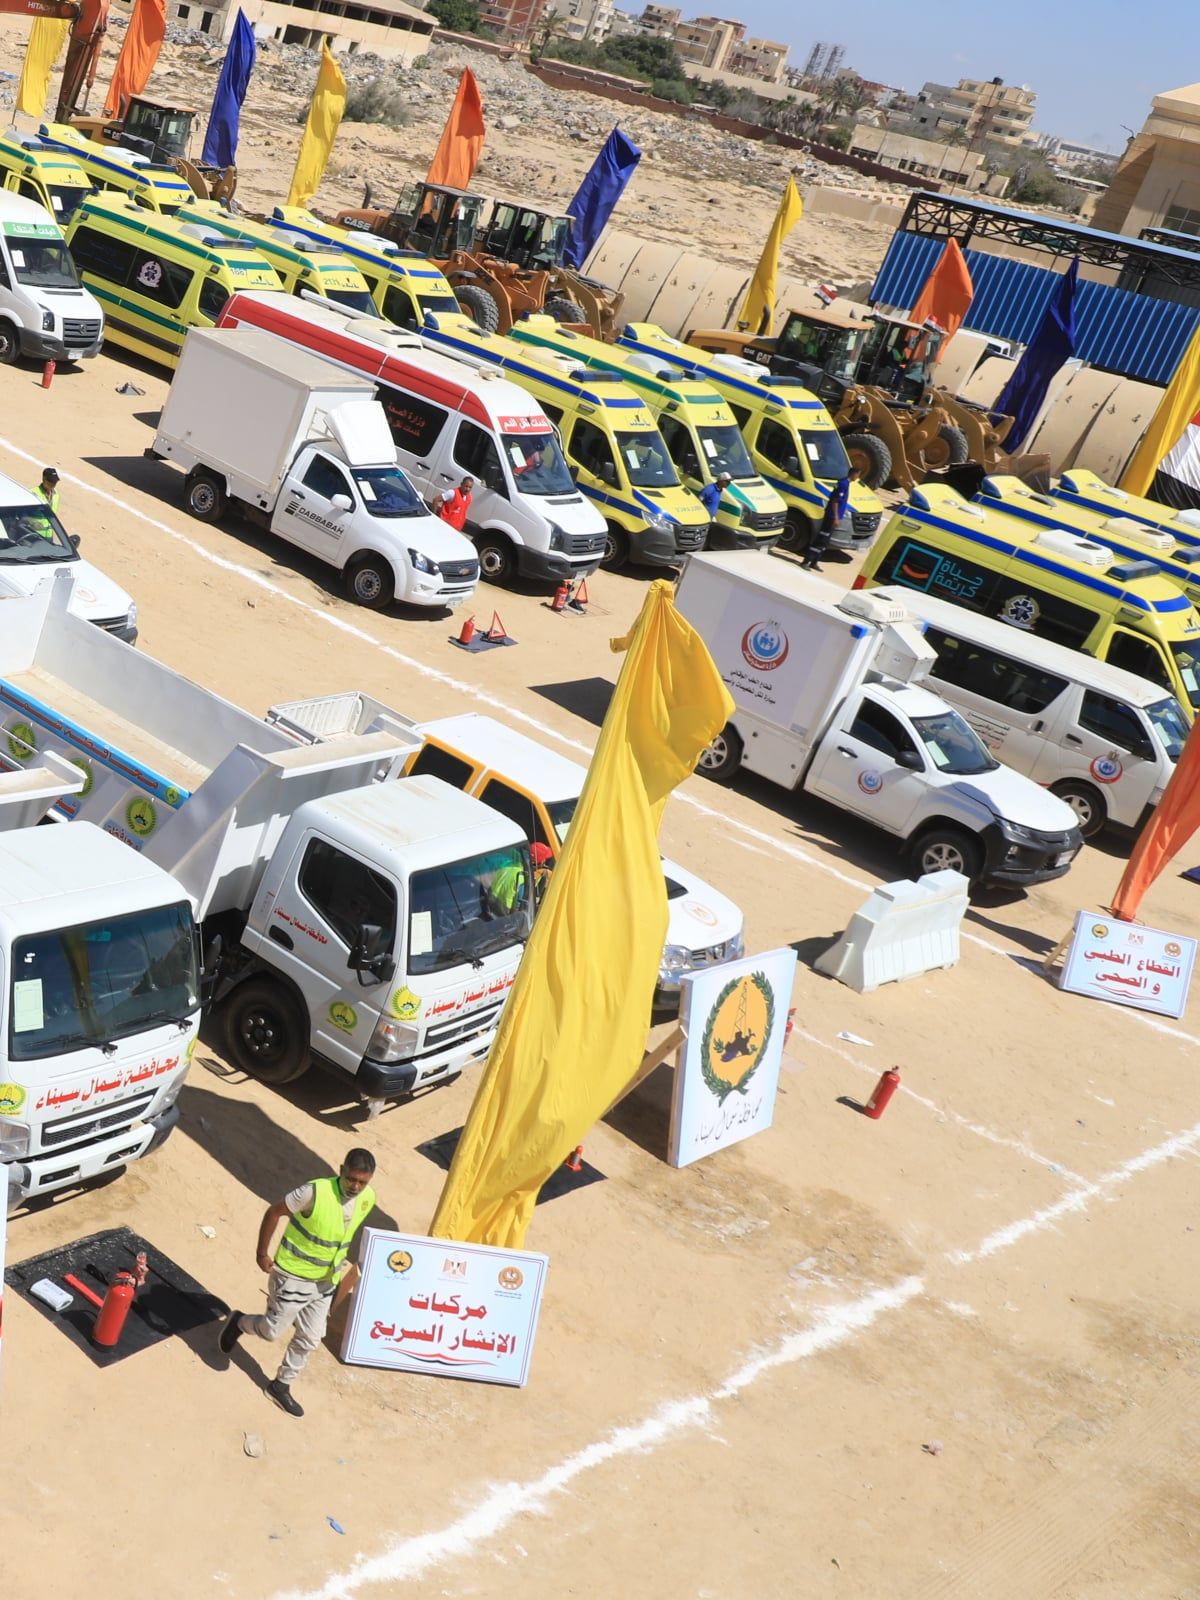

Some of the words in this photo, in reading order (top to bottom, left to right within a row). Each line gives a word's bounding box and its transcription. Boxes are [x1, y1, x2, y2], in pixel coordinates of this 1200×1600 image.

[343, 216, 371, 231] CASE
[756, 351, 773, 365] CAT
[298, 507, 344, 535] DABBABAH
[934, 571, 979, 599] كريمة
[941, 559, 984, 587] حياة
[1136, 959, 1181, 978] القطاع
[425, 1000, 456, 1019] سيناء
[455, 983, 484, 1010] شمال
[123, 1055, 180, 1087] محافظة
[35, 1086, 80, 1112] سيناء
[81, 1070, 123, 1101] شمال
[408, 1292, 488, 1321] مركبات
[369, 1320, 444, 1345] السريع
